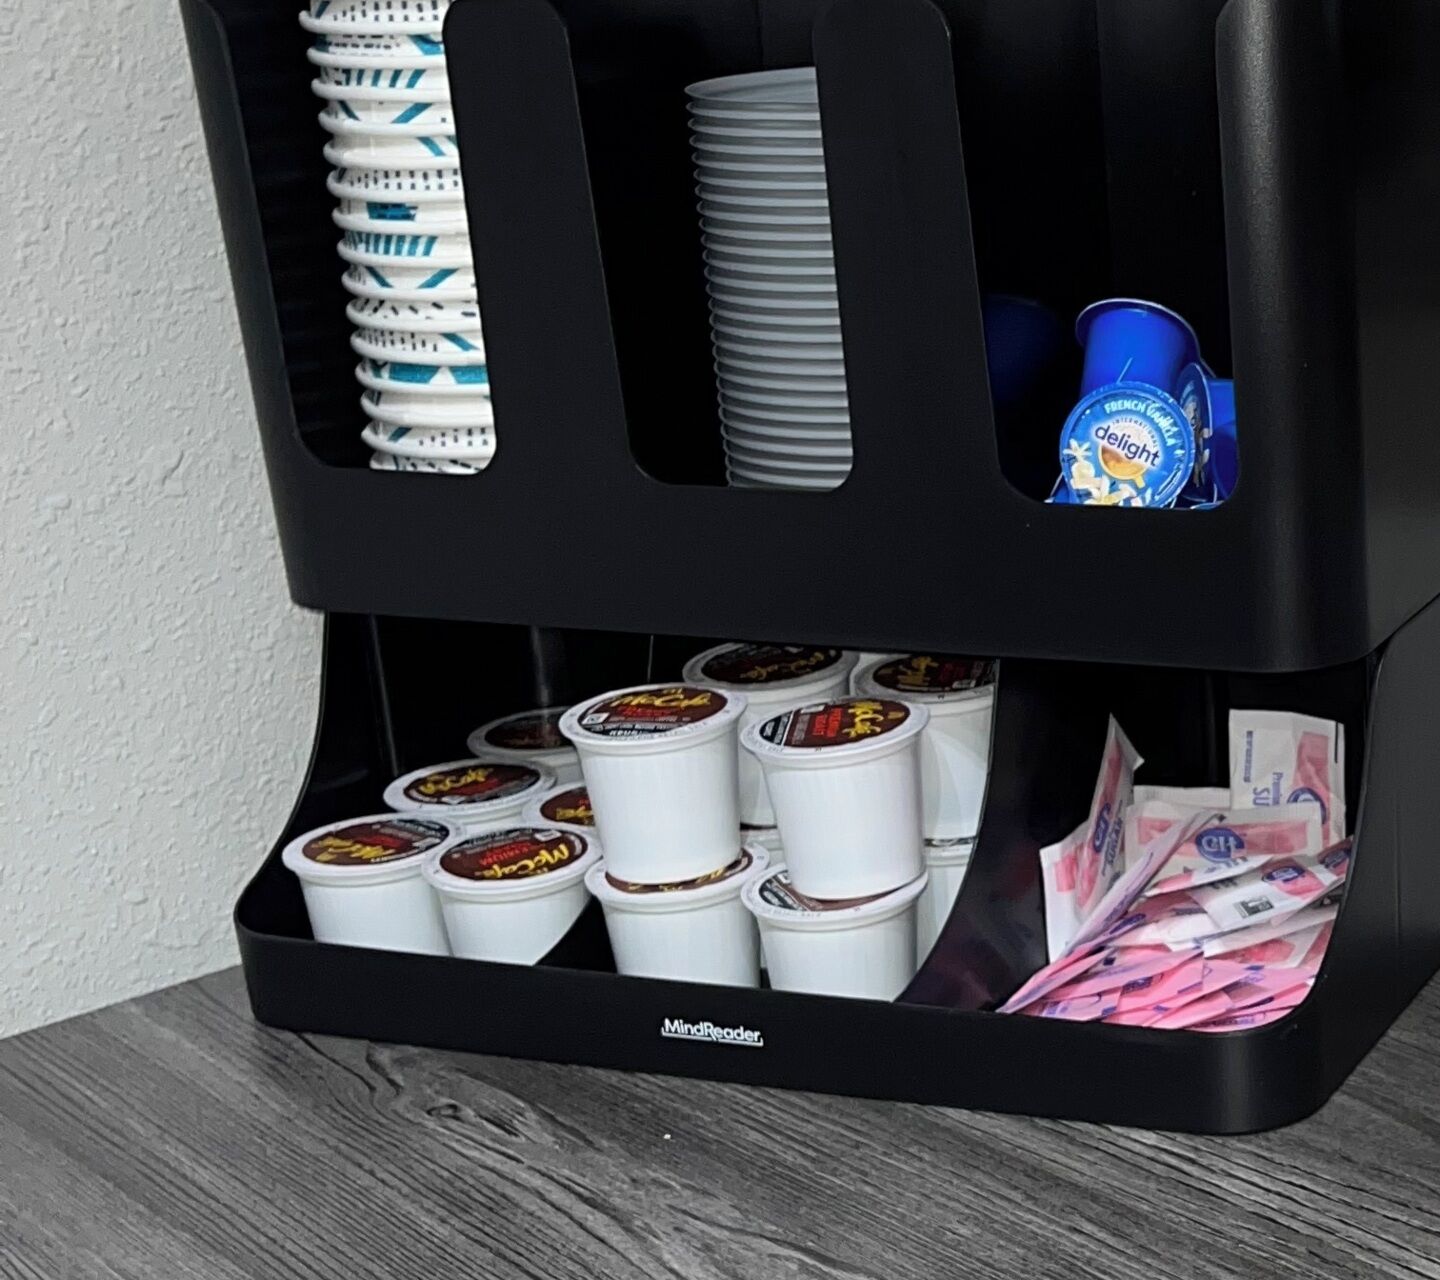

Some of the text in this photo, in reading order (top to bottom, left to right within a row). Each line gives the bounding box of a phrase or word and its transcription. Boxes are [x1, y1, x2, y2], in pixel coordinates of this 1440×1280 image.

[1104, 399, 1147, 414] FRENCH
[1094, 425, 1160, 467] delight
[663, 1017, 762, 1044] MindReader
